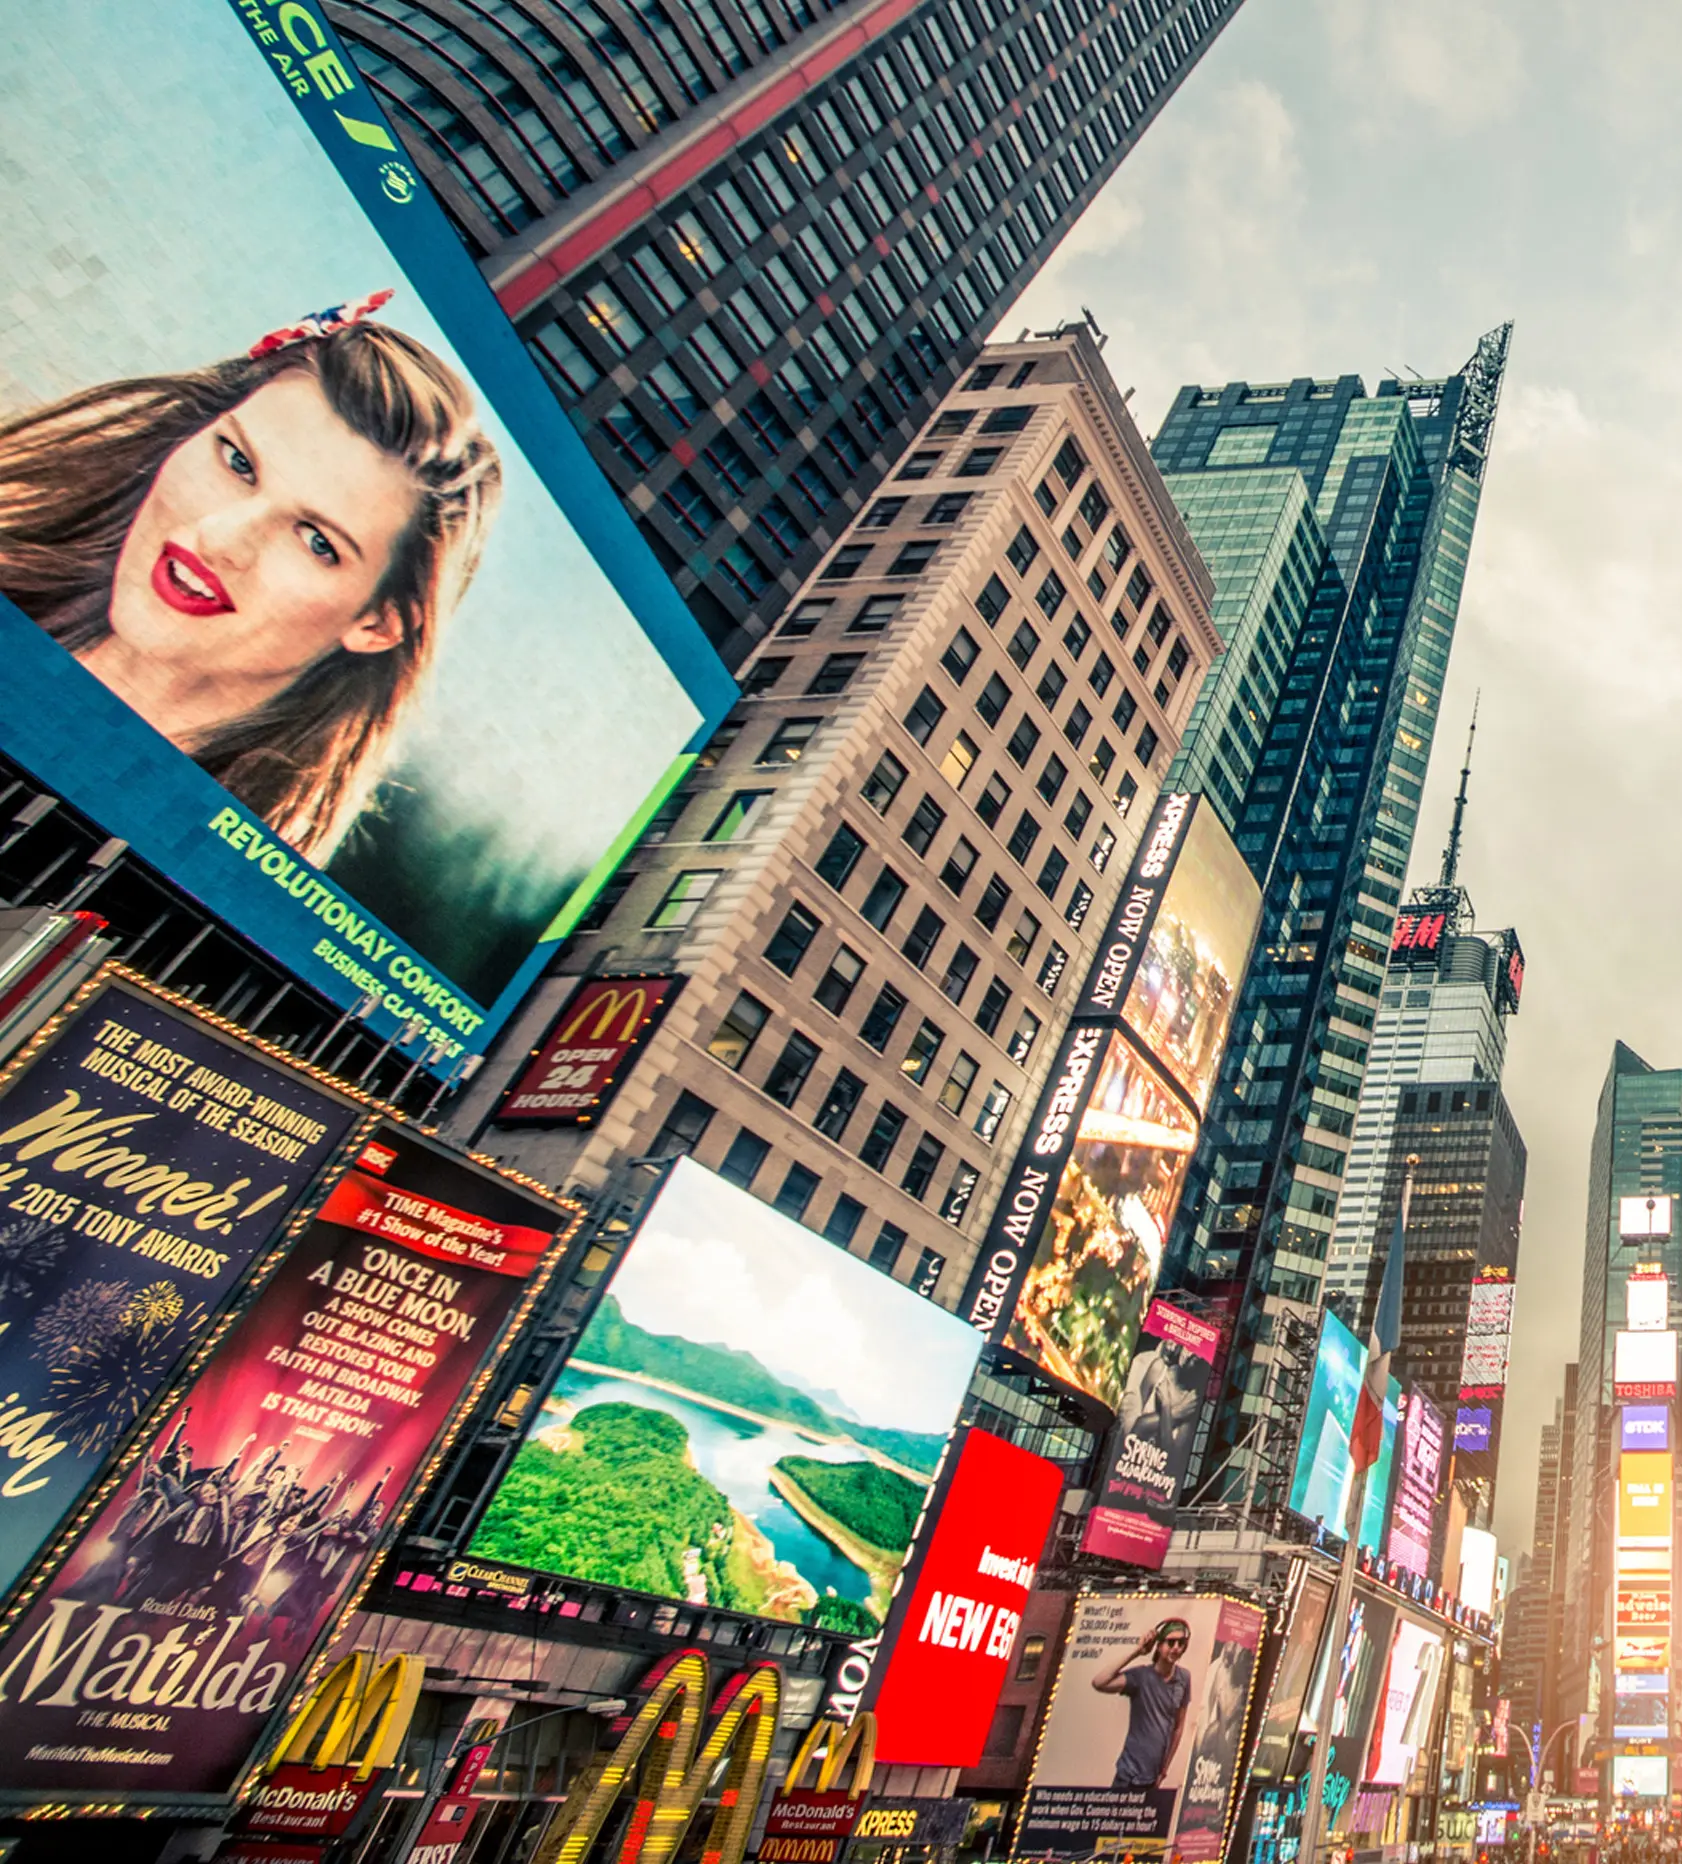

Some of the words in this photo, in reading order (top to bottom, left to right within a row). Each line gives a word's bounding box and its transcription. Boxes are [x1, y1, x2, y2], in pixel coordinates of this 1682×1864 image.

[271, 52, 310, 98] AIR
[208, 806, 396, 963] REVOLUTIONAY
[388, 955, 485, 1037] COMFORT
[1117, 885, 1155, 943] NOW
[312, 938, 388, 998] BUSINESS
[1090, 942, 1133, 1010] OPEN
[538, 1064, 599, 1090] 24
[550, 1048, 618, 1063] OPEN
[80, 1046, 171, 1103] MUSICAL
[168, 1088, 199, 1114] OF
[195, 1099, 237, 1134] THE
[229, 1116, 308, 1164] SEASON!
[93, 1019, 142, 1048] THE
[131, 1039, 194, 1080] MOST
[185, 1066, 328, 1145] AWARD-WINNING
[511, 1092, 597, 1109] HOURS
[384, 1191, 430, 1219] TIME
[424, 1206, 505, 1245] Magazine's
[1003, 1166, 1050, 1248] NOW
[8, 1182, 82, 1225] 2015
[72, 1203, 145, 1248] TONY
[131, 1229, 231, 1279] AWARDS
[357, 1208, 382, 1227] #1
[380, 1215, 427, 1241] Show
[423, 1232, 447, 1247] of
[440, 1236, 468, 1256] the
[467, 1242, 507, 1268] Year!
[308, 1260, 334, 1286] A
[333, 1266, 406, 1310] BLUE
[396, 1290, 478, 1343] MOON,
[428, 1273, 464, 1301] IN
[969, 1250, 1019, 1343] OPEN
[301, 1310, 343, 1335] OUT
[336, 1320, 406, 1359] BLAZING
[398, 1343, 437, 1369] AND
[325, 1296, 340, 1313] A
[335, 1300, 393, 1331] SHOW
[388, 1319, 440, 1347] COMES
[265, 1345, 321, 1376] FAITH
[315, 1359, 338, 1381] IN
[335, 1366, 425, 1409] BROADWAY.
[298, 1331, 377, 1371] RESTORES
[373, 1355, 418, 1384] YOUR
[260, 1390, 279, 1410] IS
[276, 1394, 328, 1422] THAT
[297, 1379, 373, 1414] MATILDA
[1614, 1383, 1676, 1397] TOSHIBA
[1121, 1433, 1168, 1472] SPRING
[977, 1544, 1022, 1583] Invest
[138, 1597, 177, 1618] Roald
[177, 1602, 220, 1623] Dahl's
[918, 1590, 995, 1653] NEW
[1113, 1623, 1131, 1633] year
[0, 1597, 288, 1714] Matilda
[1075, 1635, 1093, 1645] with
[1100, 1636, 1141, 1647] experience
[75, 1710, 107, 1727] THE
[107, 1710, 173, 1733] MUSICAL
[457, 1751, 485, 1795] OPEN
[249, 1785, 358, 1813] McDonald's
[250, 1811, 329, 1828] Restaurant
[771, 1803, 855, 1820] McDonald's
[780, 1820, 837, 1832] Restaurant
